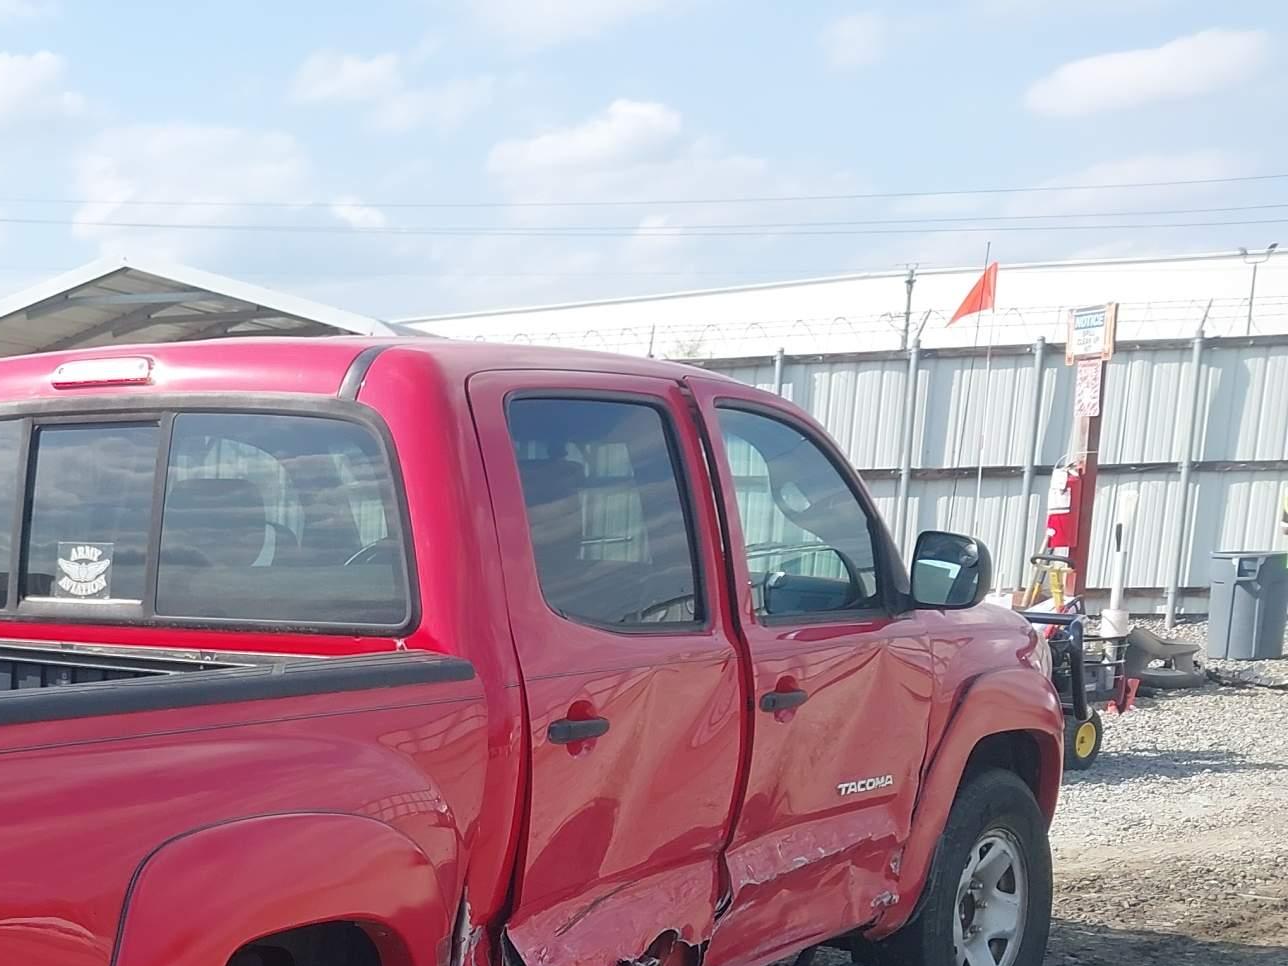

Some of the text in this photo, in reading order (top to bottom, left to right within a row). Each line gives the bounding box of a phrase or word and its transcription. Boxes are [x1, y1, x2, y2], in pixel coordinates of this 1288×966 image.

[1075, 314, 1105, 328] NOTICE
[71, 545, 103, 561] ARMY
[58, 574, 107, 595] AVIATION
[837, 774, 893, 796] TACOMA
